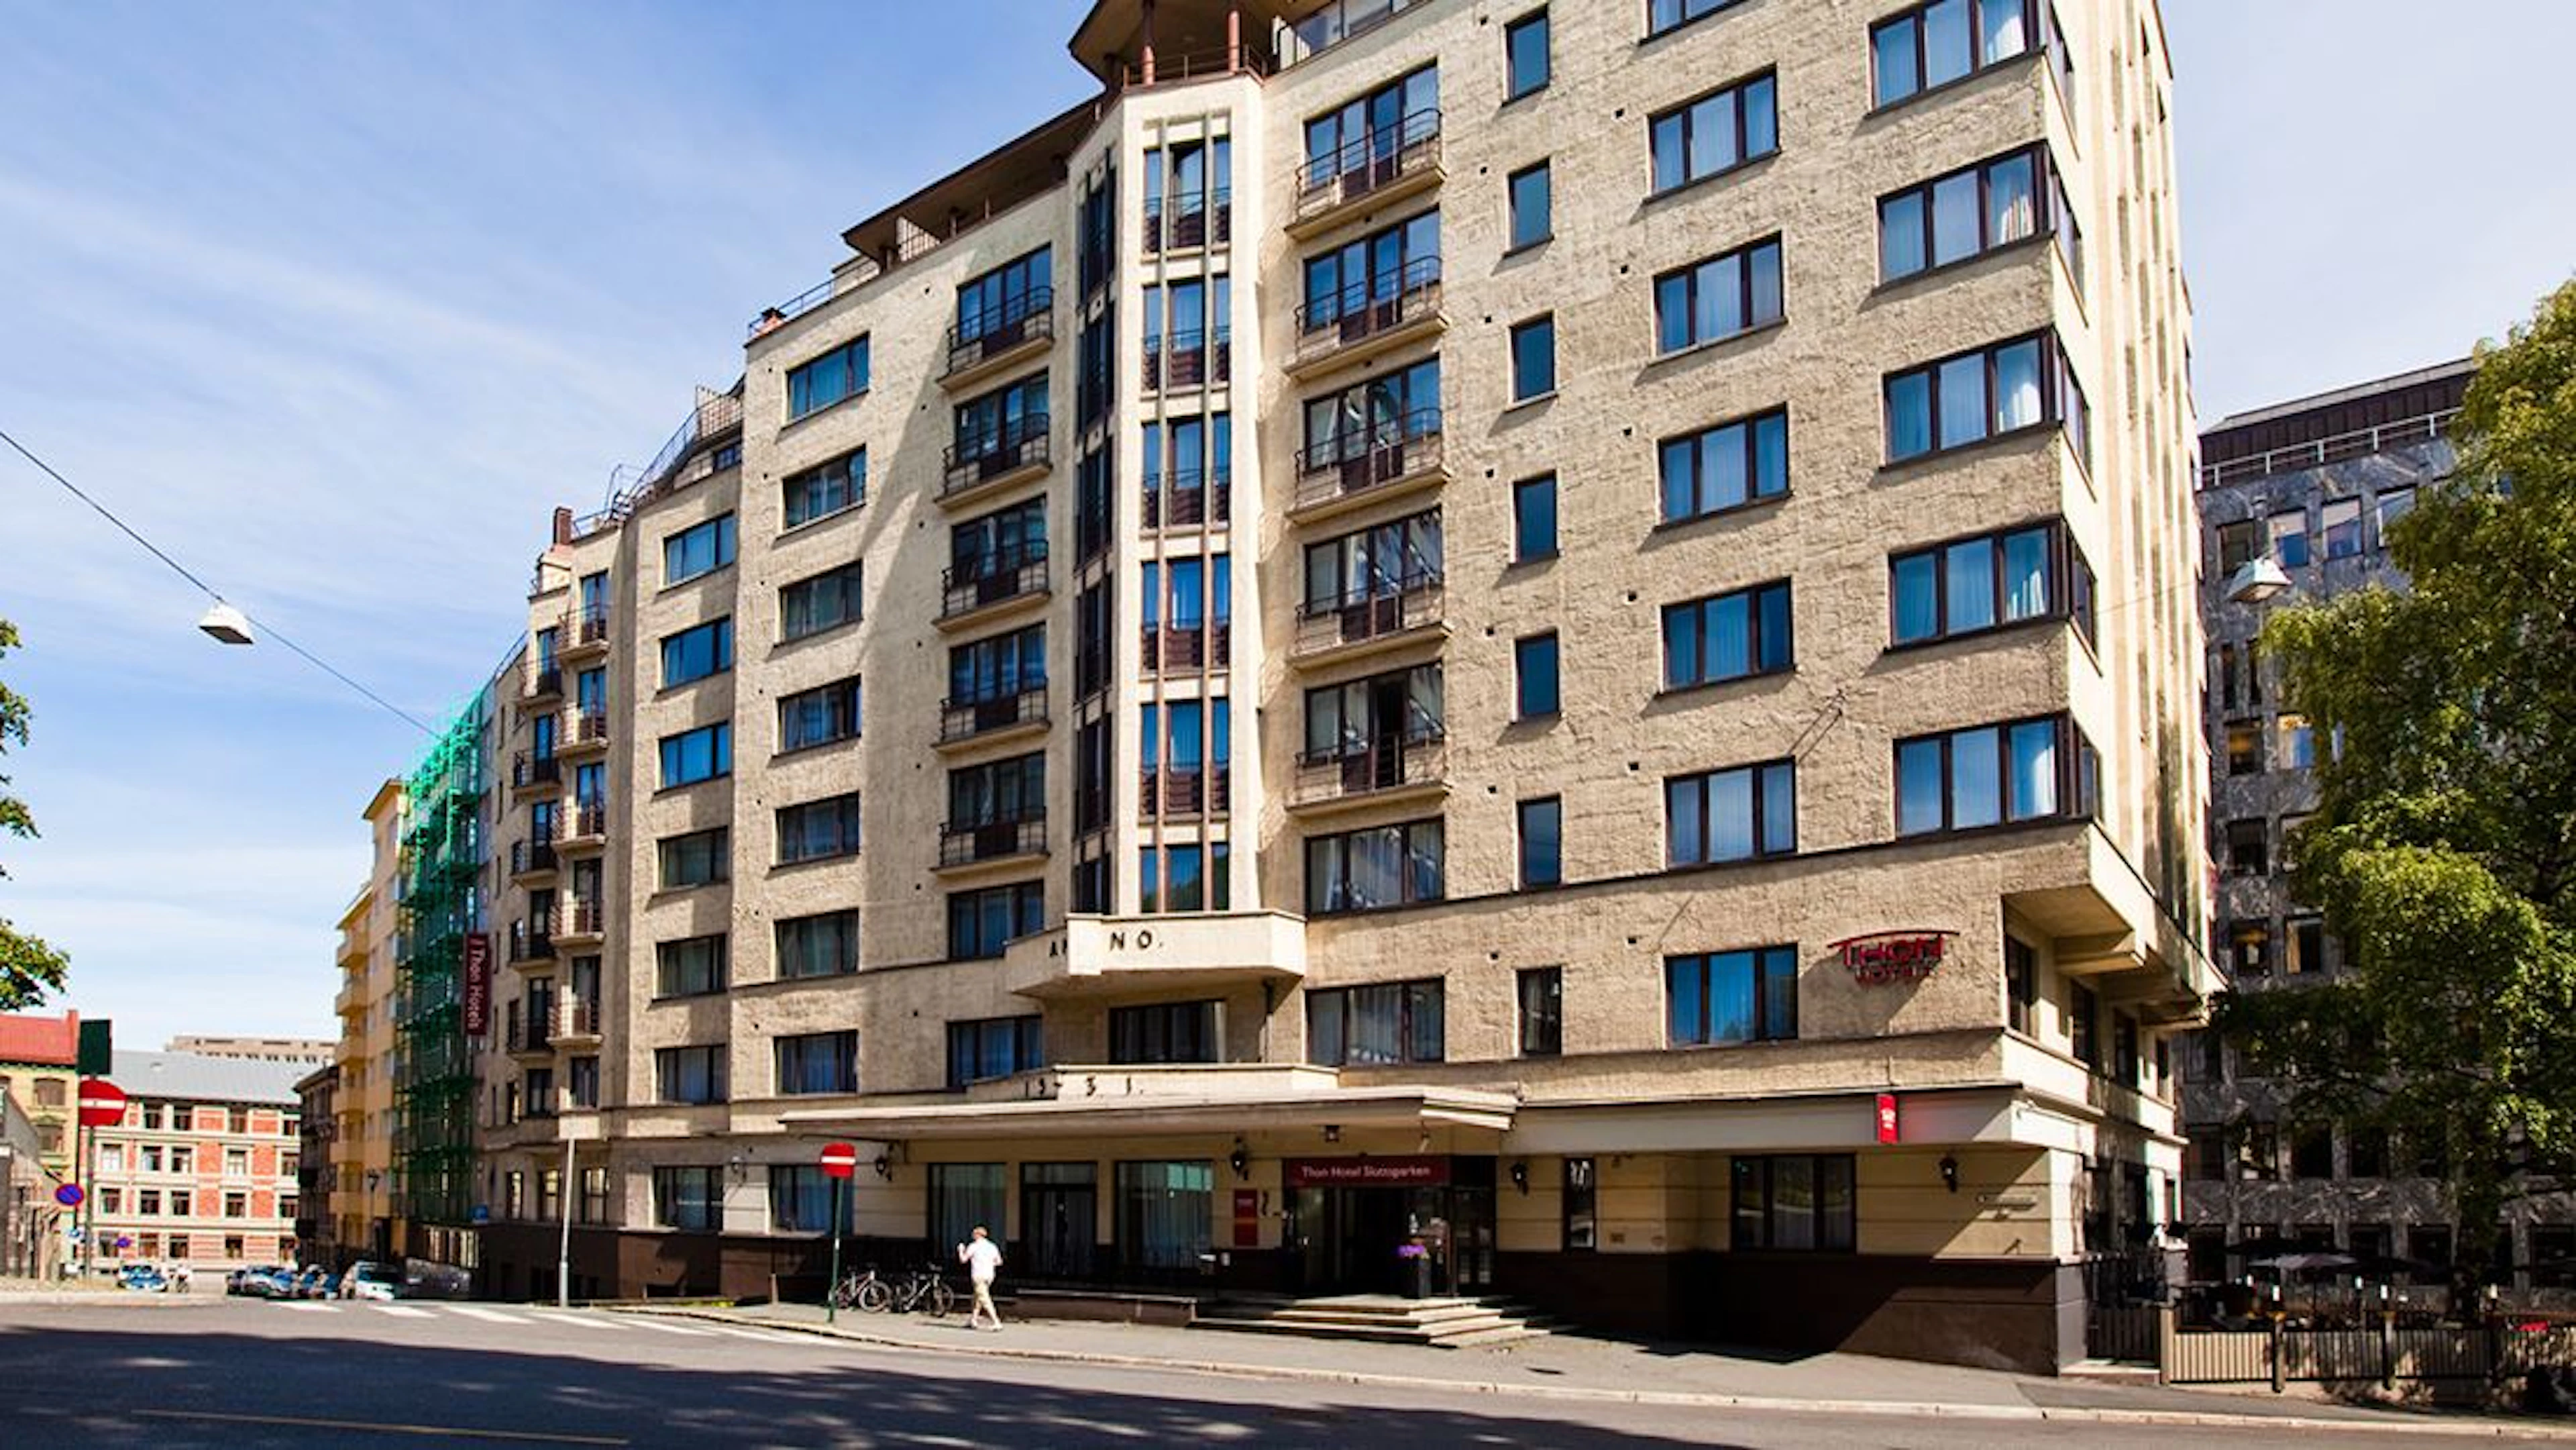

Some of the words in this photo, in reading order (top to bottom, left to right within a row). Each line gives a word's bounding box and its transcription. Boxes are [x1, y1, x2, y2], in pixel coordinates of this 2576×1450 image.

[470, 948, 486, 982] Thon
[1827, 930, 1960, 967] THON
[1301, 1166, 1329, 1178] Thon
